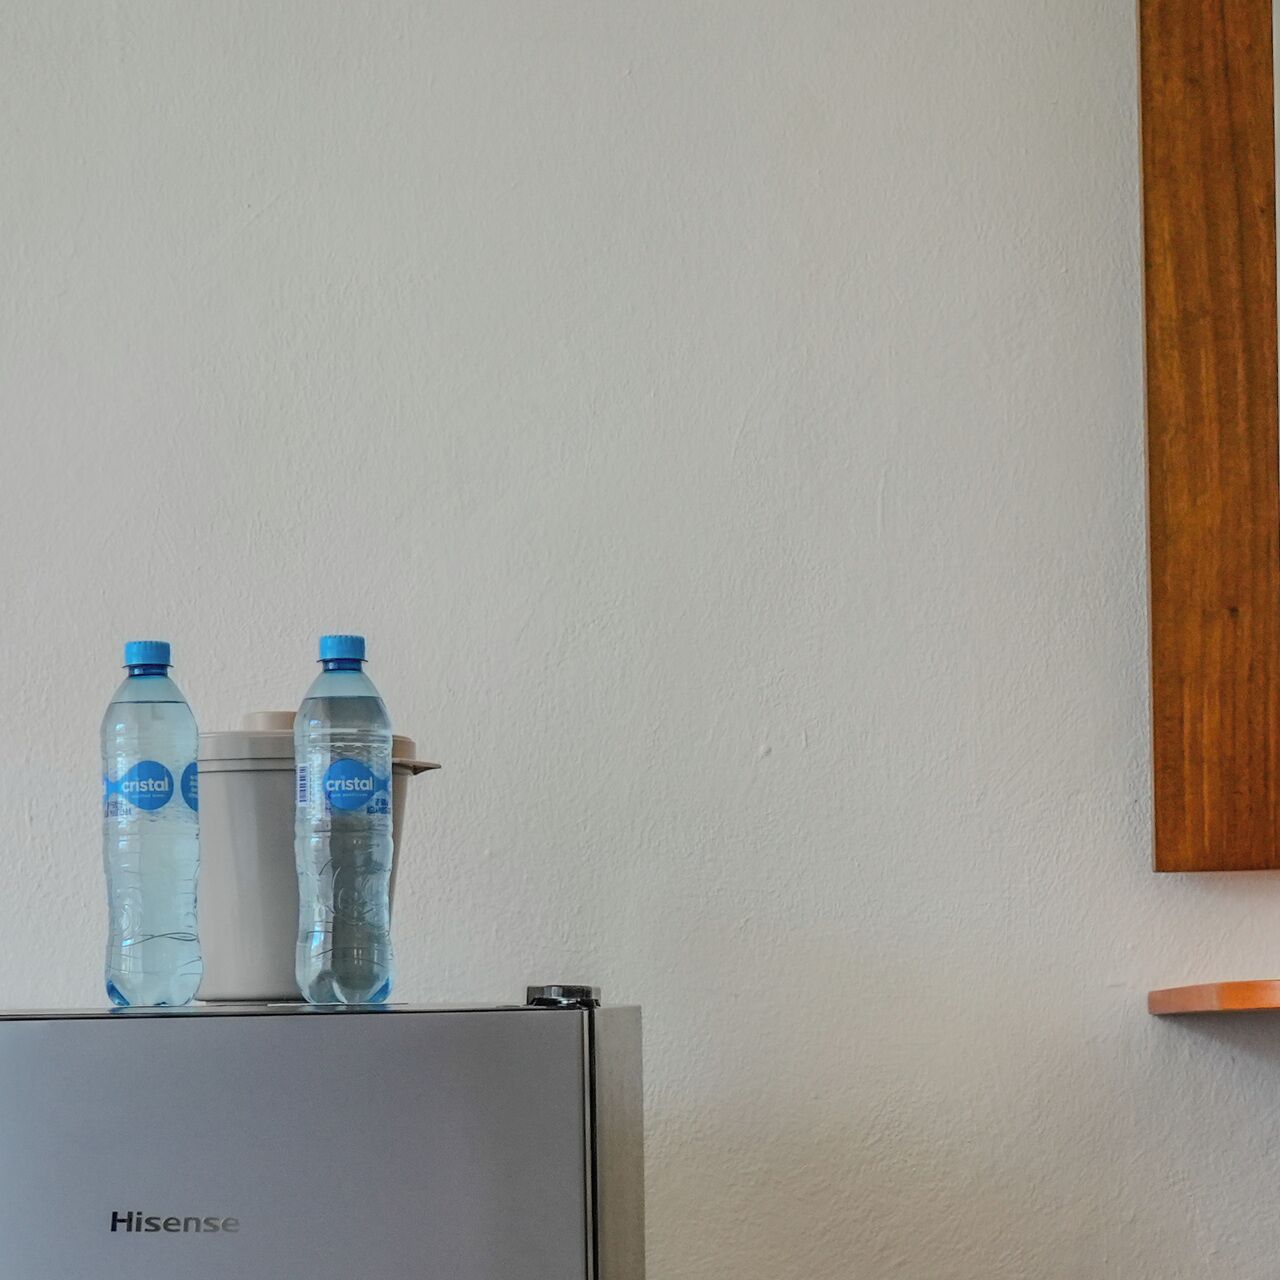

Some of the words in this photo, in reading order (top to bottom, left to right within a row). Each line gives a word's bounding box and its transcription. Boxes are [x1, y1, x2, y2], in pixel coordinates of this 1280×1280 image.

[122, 772, 169, 792] cristal
[326, 775, 374, 791] cristal
[111, 1211, 240, 1233] Hisense
